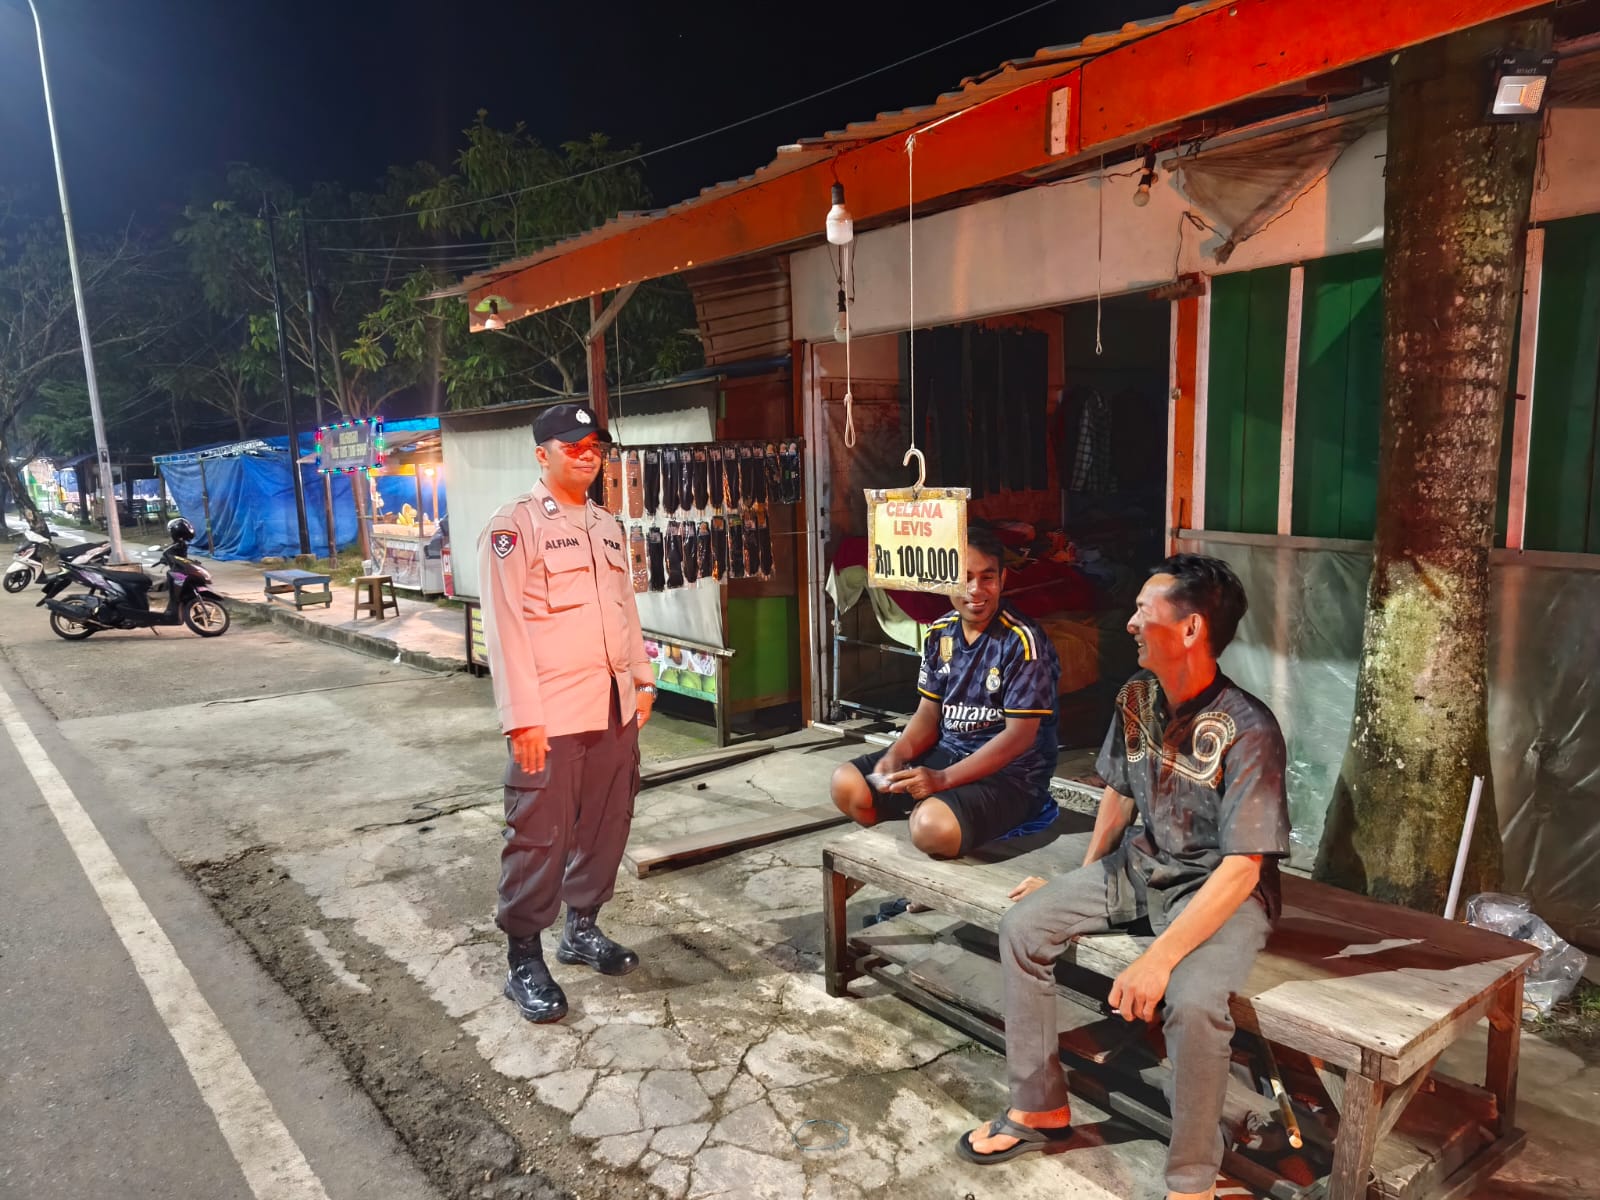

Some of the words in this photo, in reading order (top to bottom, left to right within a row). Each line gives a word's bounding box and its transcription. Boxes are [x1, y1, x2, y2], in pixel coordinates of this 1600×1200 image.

[886, 502, 943, 518] CELANA
[893, 521, 932, 537] LEVIS
[545, 538, 580, 550] ALFIAN
[875, 544, 895, 578] Rp.
[897, 545, 959, 581] 100.000
[942, 701, 1004, 721] mirates
